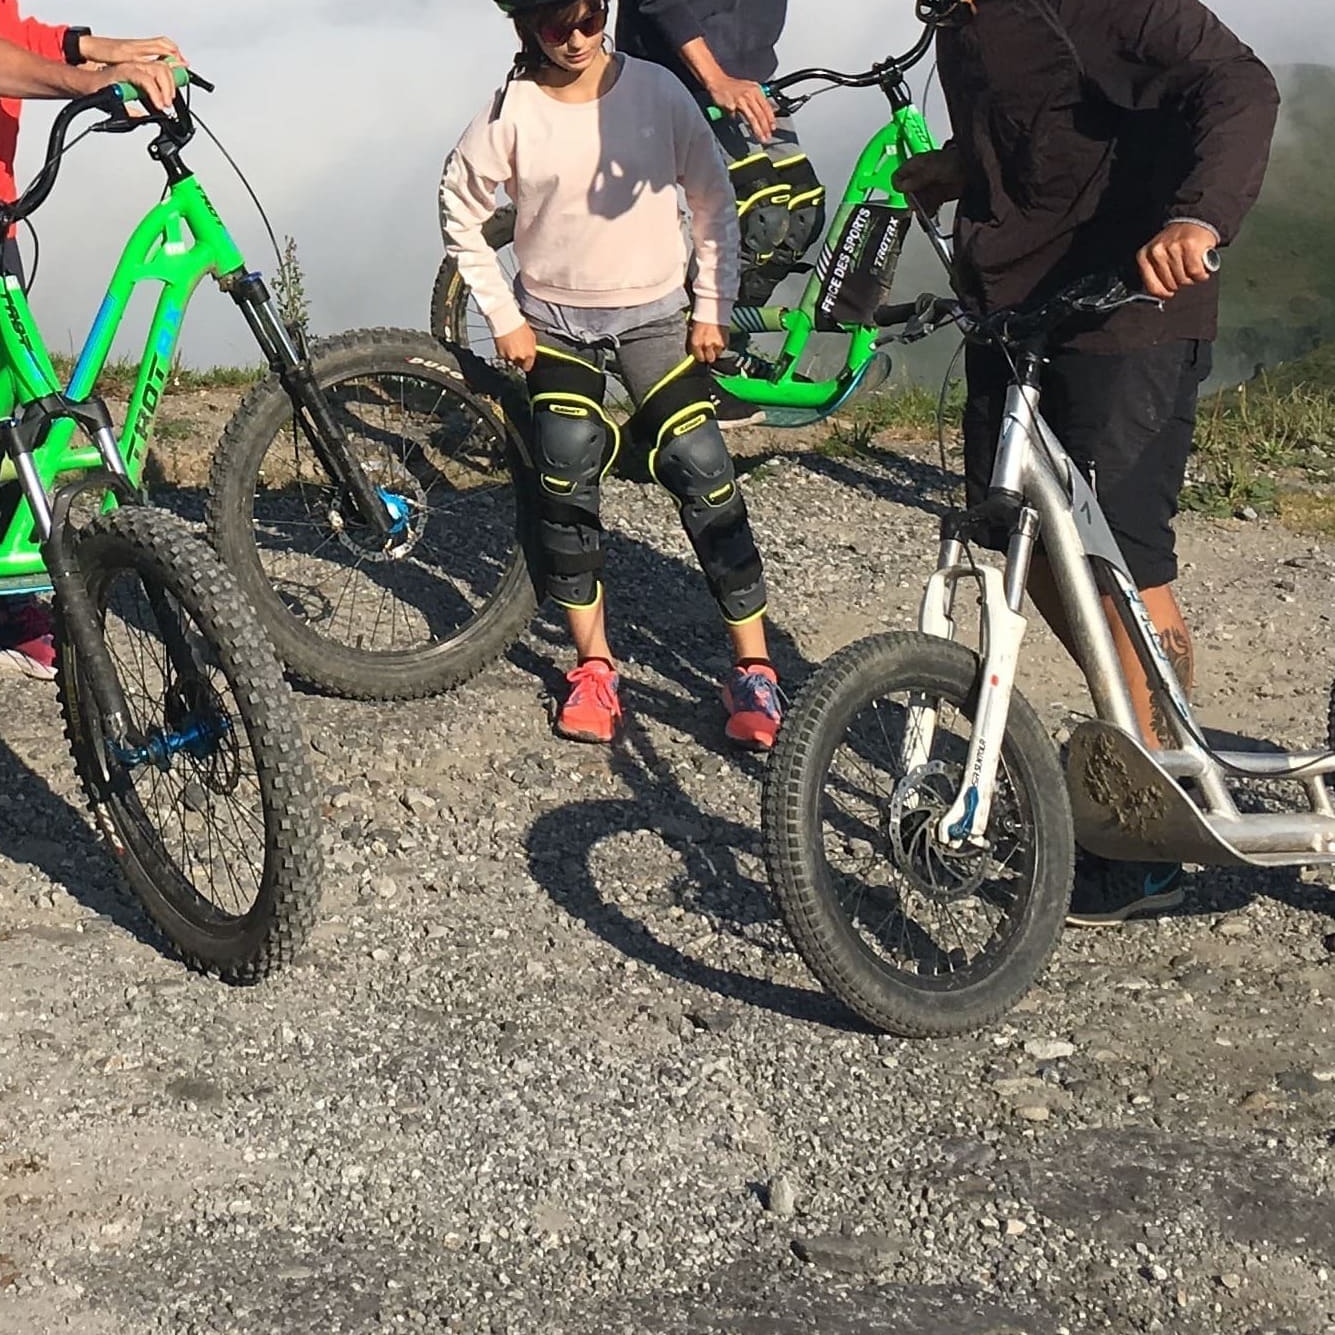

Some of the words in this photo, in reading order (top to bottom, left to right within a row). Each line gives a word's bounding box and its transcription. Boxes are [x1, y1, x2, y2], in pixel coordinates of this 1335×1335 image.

[821, 277, 843, 316] FFICE
[833, 253, 850, 277] DES
[843, 208, 871, 253] SPORTS
[874, 216, 899, 267] TROTRX
